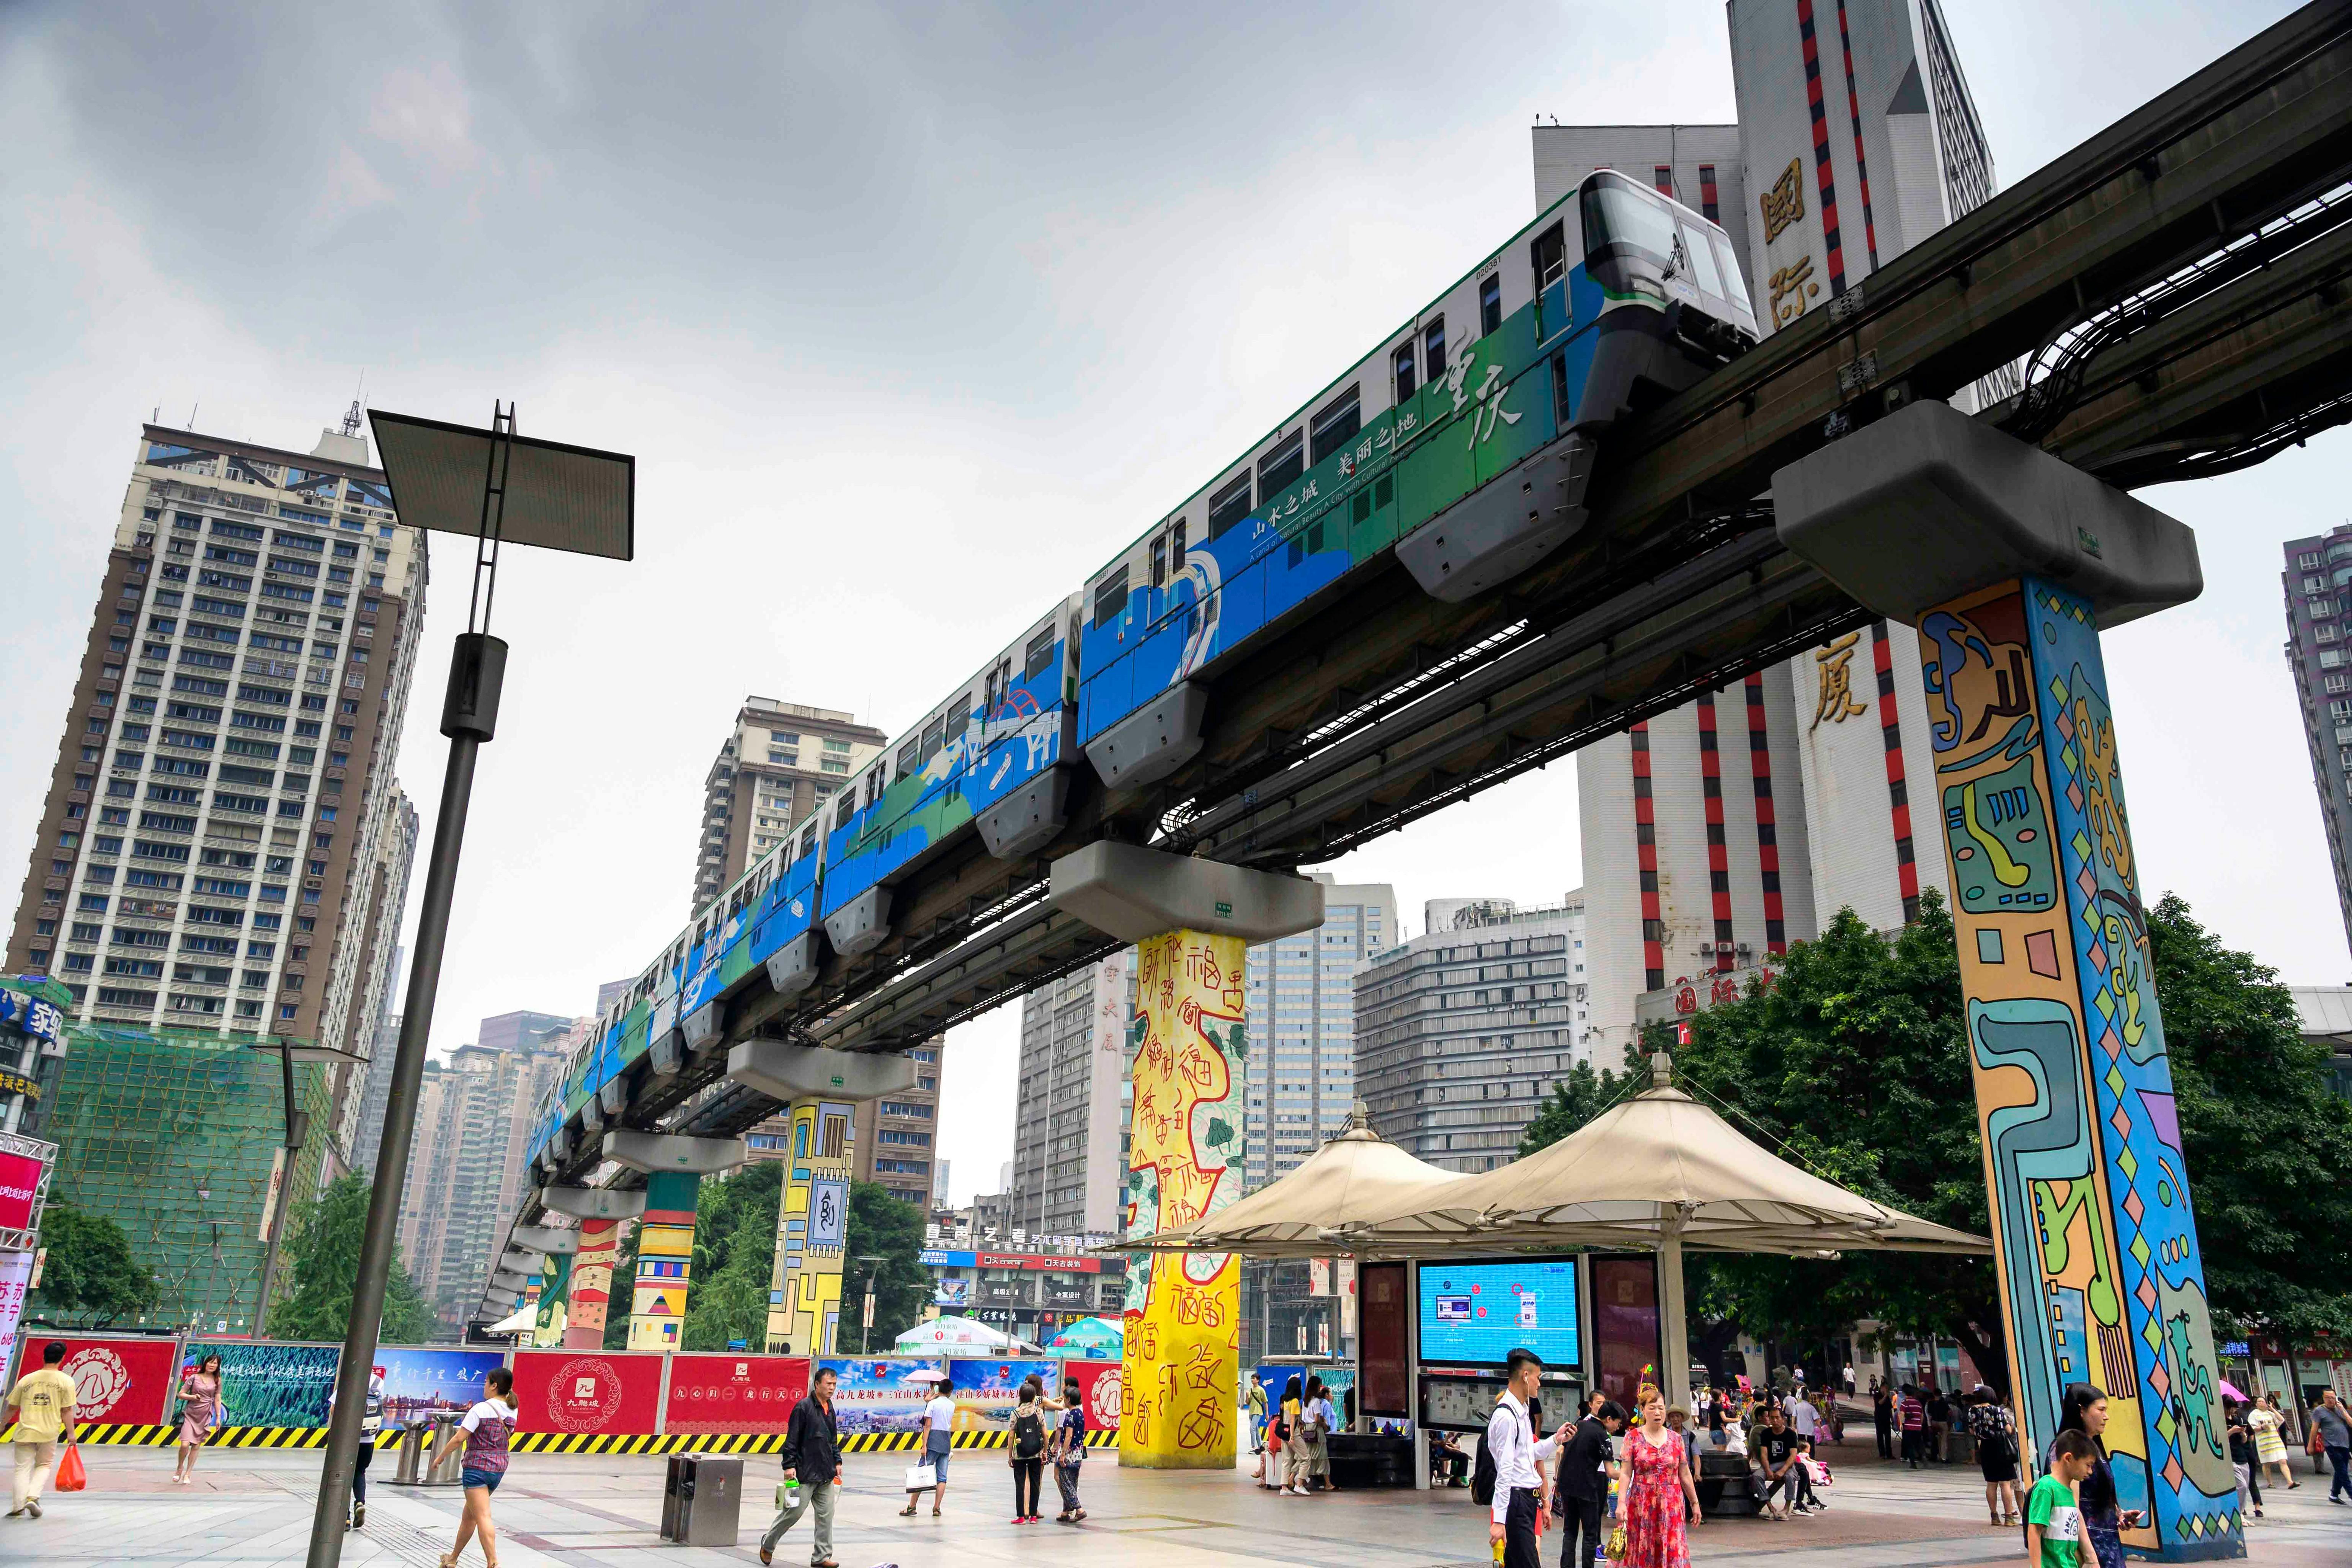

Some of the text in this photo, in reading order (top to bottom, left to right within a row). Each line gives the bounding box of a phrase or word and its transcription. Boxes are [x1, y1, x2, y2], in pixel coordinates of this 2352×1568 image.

[1253, 413, 1417, 540] 山水之城 美丽之地
[1250, 555, 1254, 563] A
[1256, 544, 1269, 559] Land
[1271, 539, 1278, 548] of
[1279, 525, 1300, 539] Natural
[1302, 507, 1323, 526] Beauty
[1324, 501, 1330, 509] A
[1331, 492, 1343, 505] City
[1345, 479, 1360, 493] with
[1362, 462, 1387, 481] Cultural
[1808, 632, 1868, 730] 厦
[1052, 1259, 1081, 1268] 天古装饰
[1055, 1291, 1081, 1299] 全案设计
[1, 1333, 14, 1346] 618
[676, 1389, 802, 1399] 九心归一 龙行天下
[831, 1389, 875, 1400] 高九龙坡
[956, 1389, 1000, 1399] 江山多娇城
